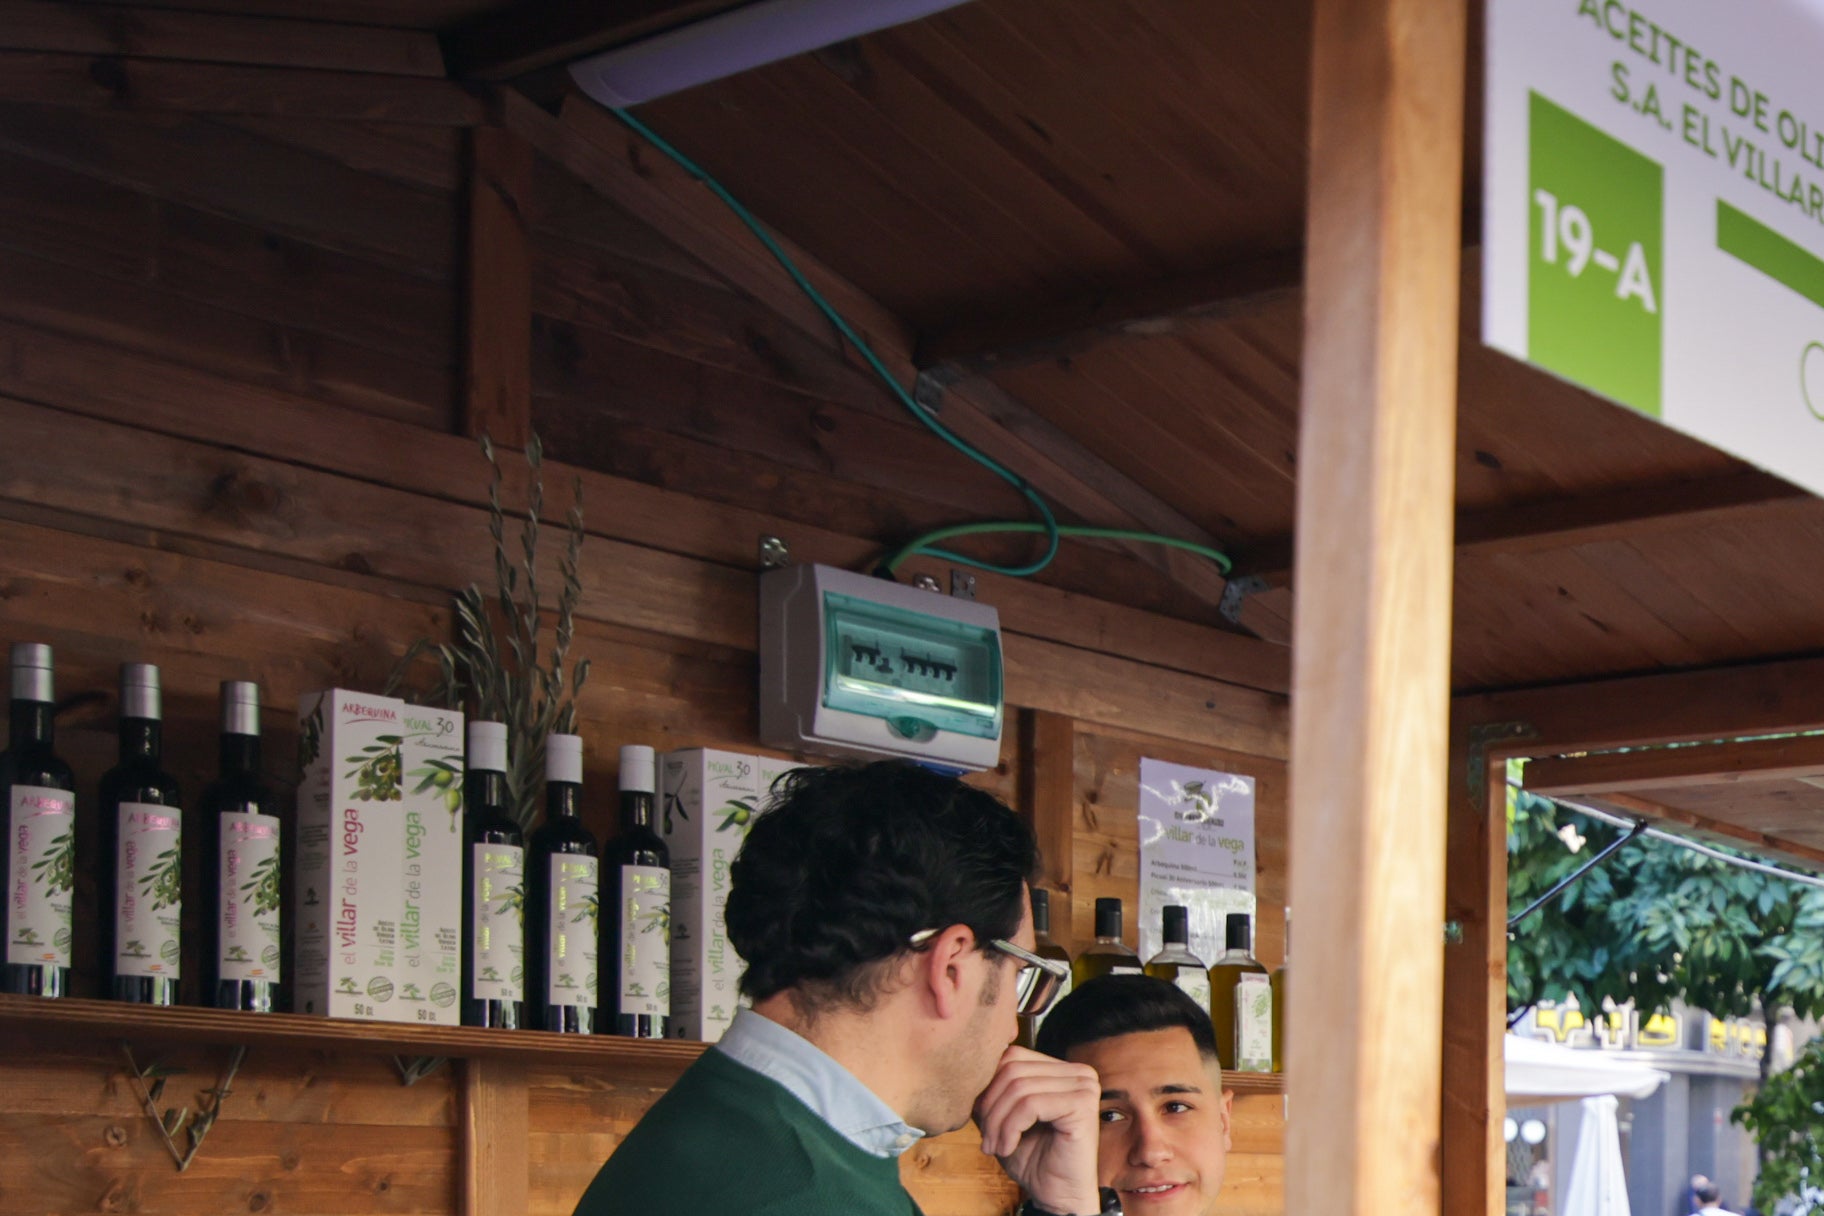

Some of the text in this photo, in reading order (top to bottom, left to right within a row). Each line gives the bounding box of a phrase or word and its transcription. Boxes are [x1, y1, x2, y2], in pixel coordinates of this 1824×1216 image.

[1578, 0, 1720, 99] ACEITES
[1731, 75, 1770, 133] DE
[1611, 60, 1673, 131] S.A.
[1682, 104, 1717, 157] EL
[1722, 126, 1824, 225] VILLAR
[1535, 187, 1657, 314] 19-A
[436, 717, 454, 738] 30
[736, 760, 751, 779] 30
[336, 808, 365, 965] el villar de la vega
[400, 812, 427, 968] el villar de la vega
[1165, 825, 1193, 843] villar
[1218, 836, 1245, 855] vega
[707, 848, 730, 991] el villar de la vega
